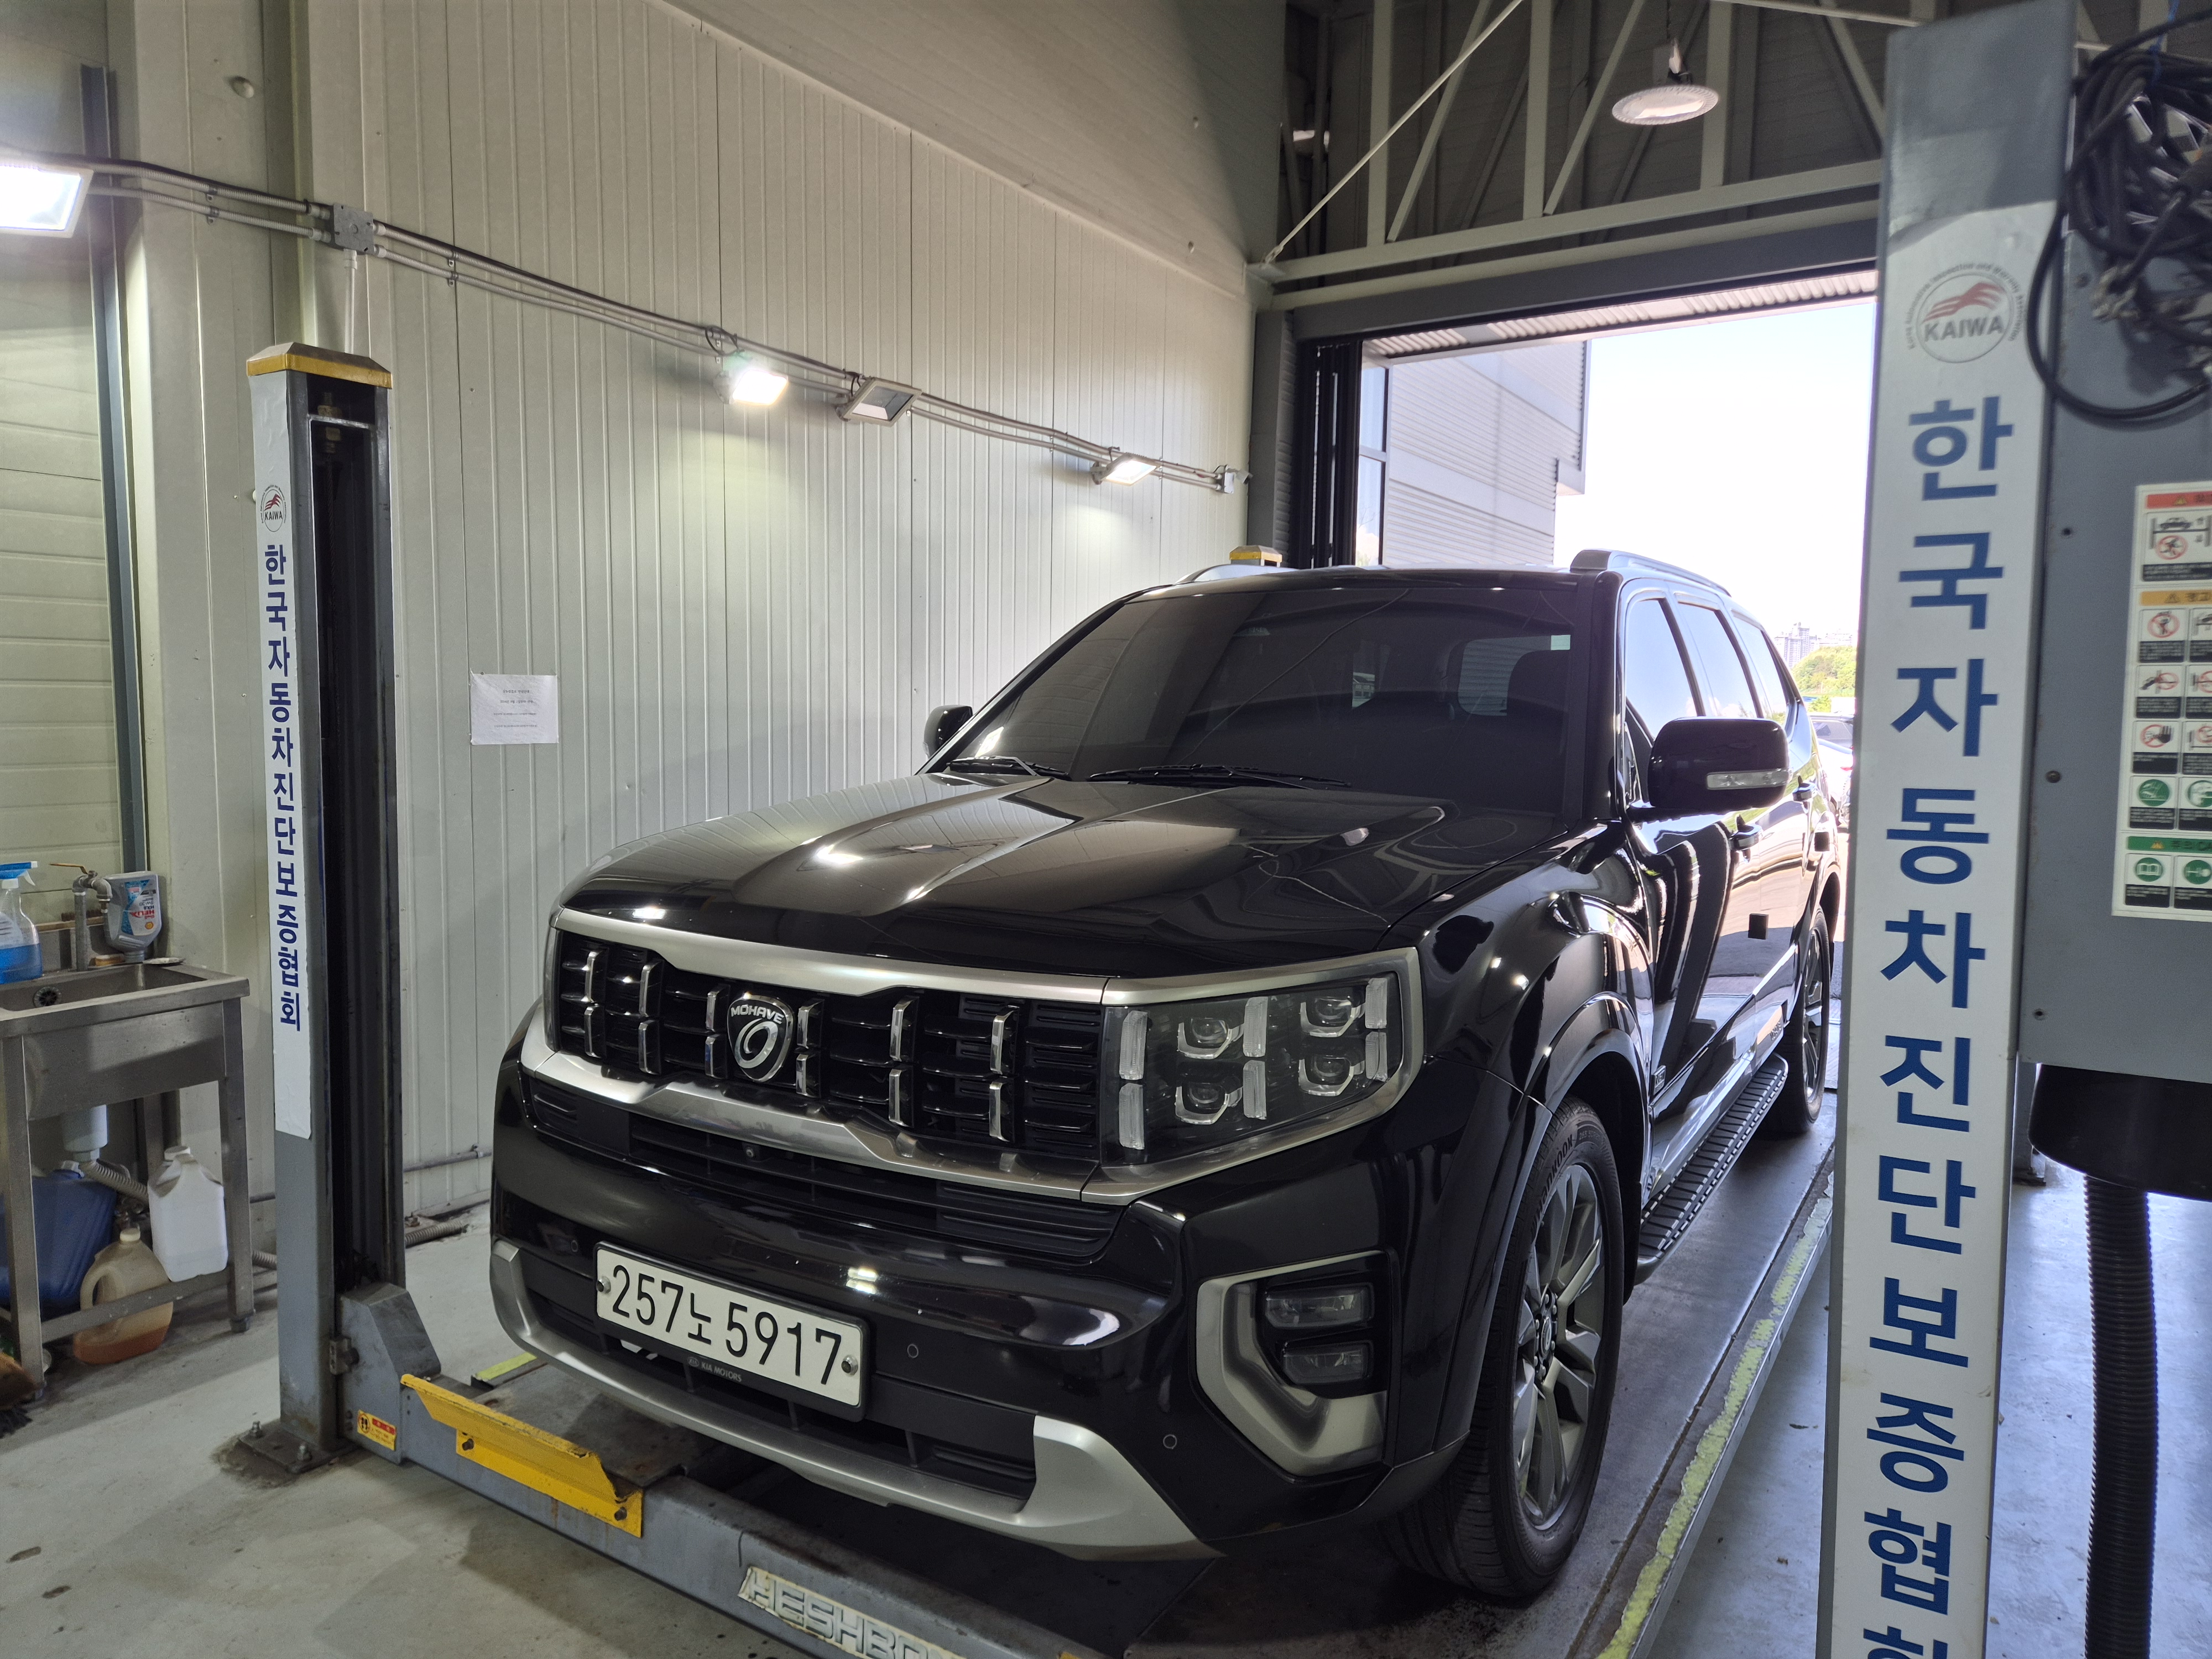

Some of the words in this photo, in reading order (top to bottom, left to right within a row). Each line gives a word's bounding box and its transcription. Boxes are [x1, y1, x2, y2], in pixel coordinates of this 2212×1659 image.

[1924, 316, 2004, 342] KAIWA
[265, 510, 283, 520] KAIWA
[264, 544, 300, 1032] 한국자동차진단보증협회
[731, 1004, 785, 1024] MOHAVE
[701, 1361, 712, 1371] KIA
[713, 1365, 742, 1382] MOTORS
